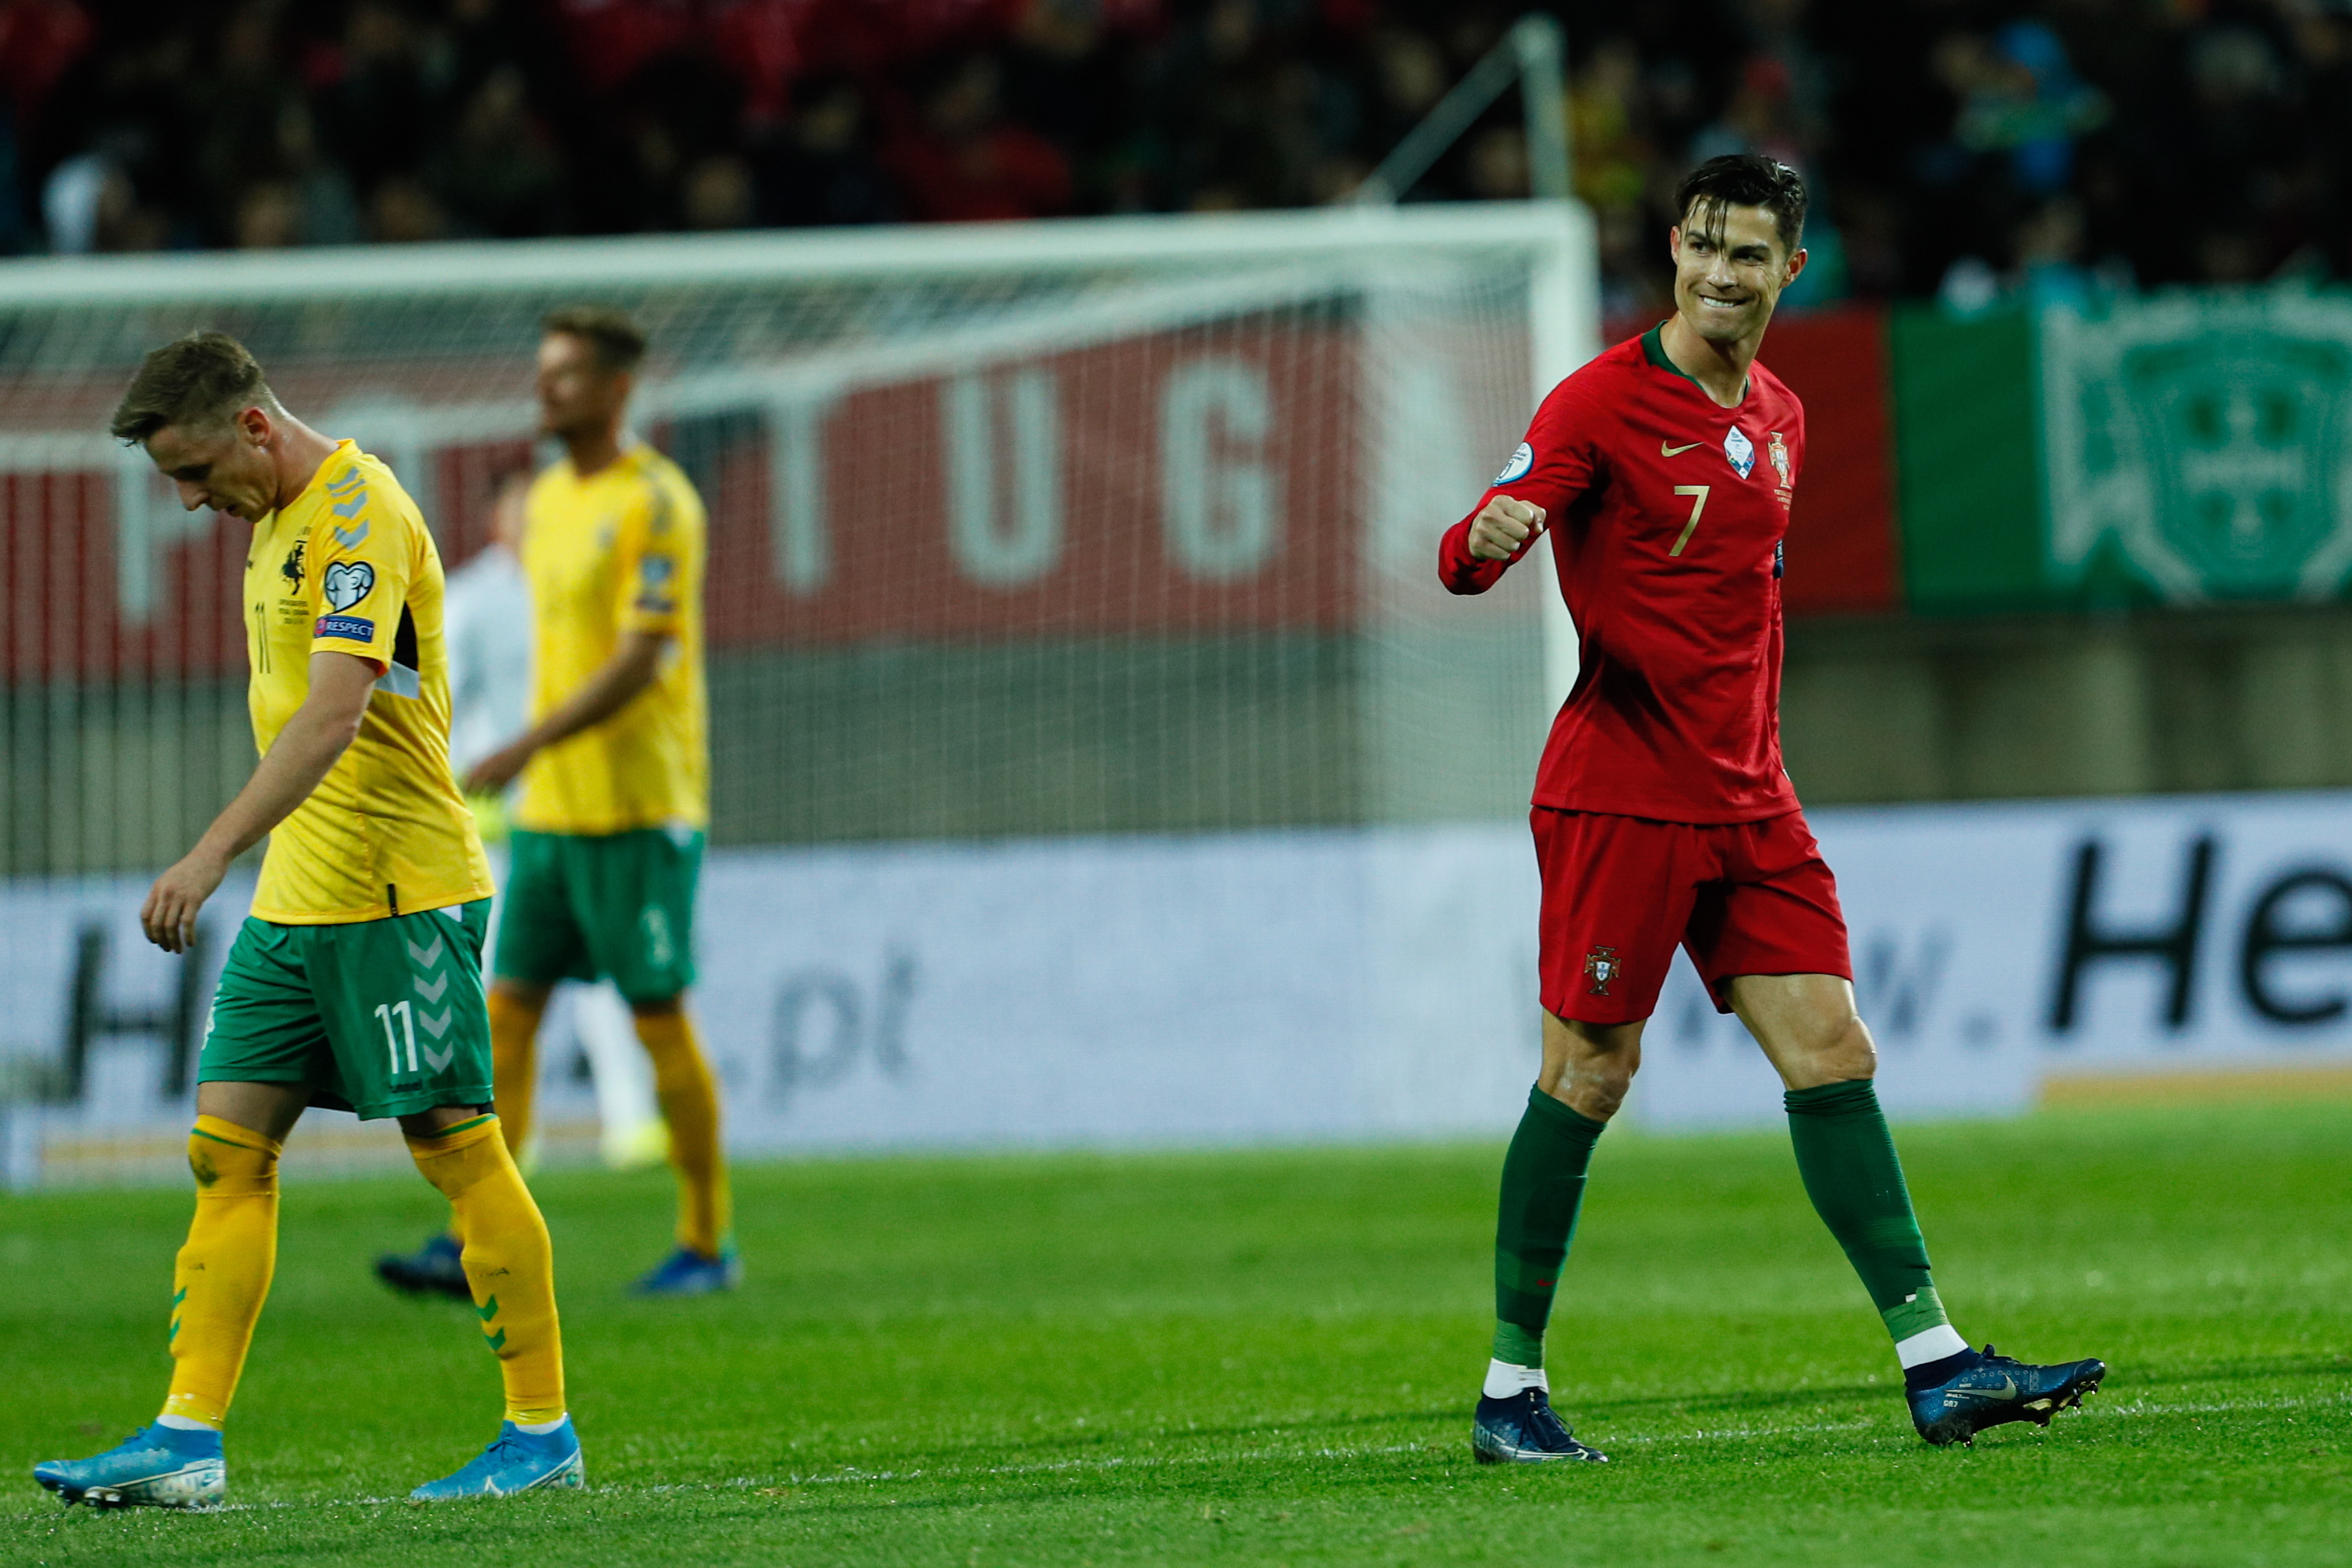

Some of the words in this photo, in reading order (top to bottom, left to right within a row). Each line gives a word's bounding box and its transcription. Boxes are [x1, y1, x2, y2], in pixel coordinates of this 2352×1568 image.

[1669, 485, 1710, 556] 7
[326, 621, 374, 637] RESPECT
[374, 1000, 418, 1075] 11
